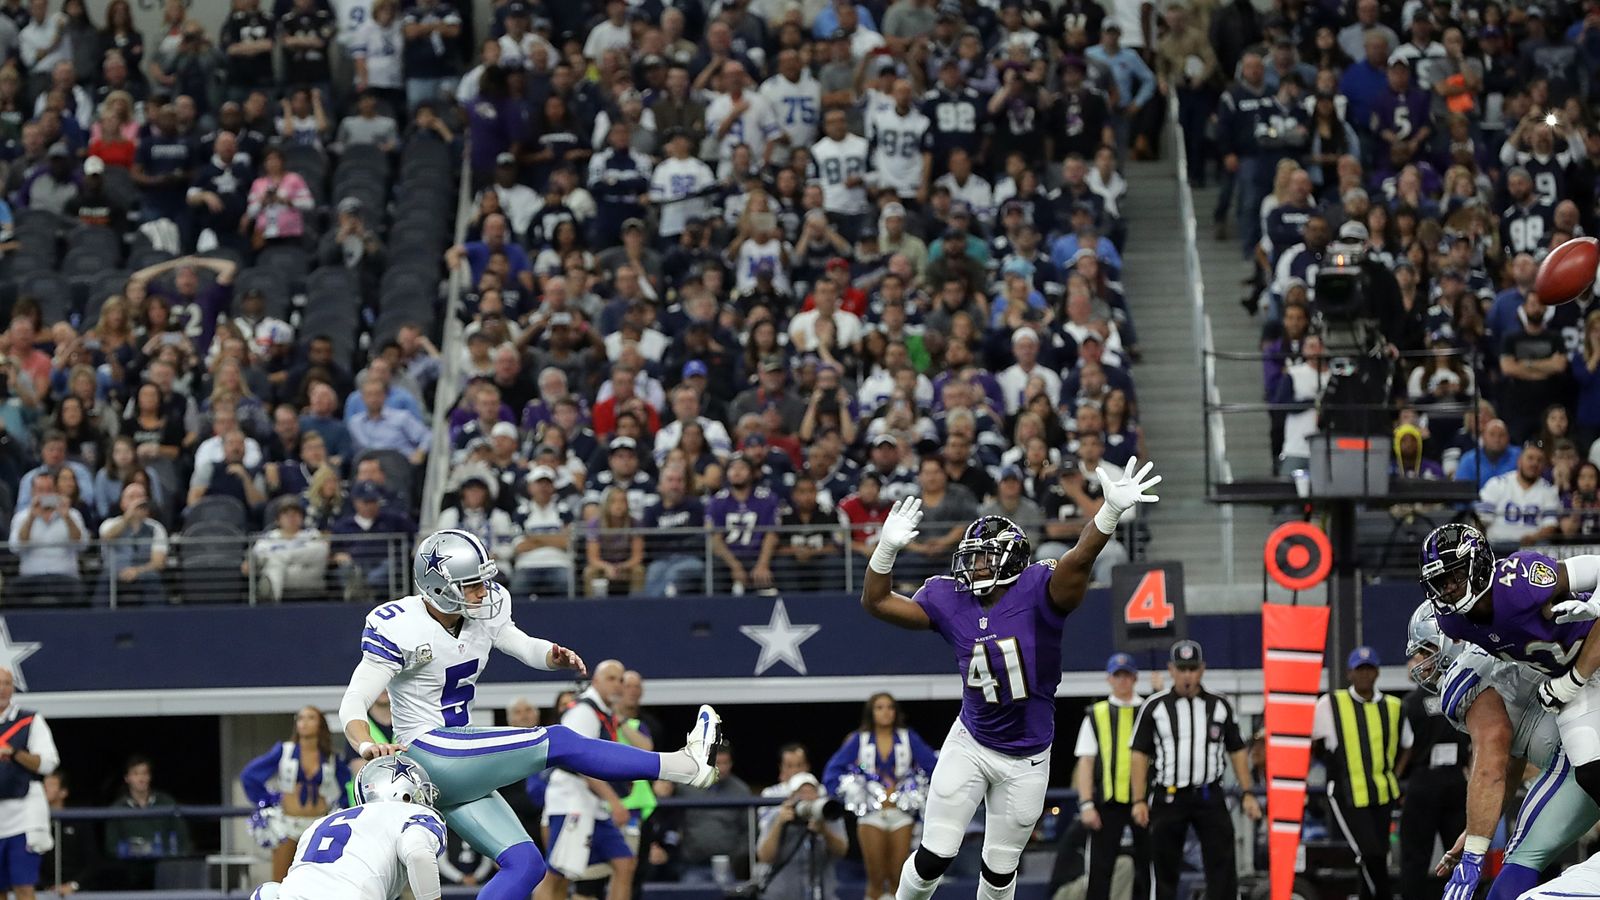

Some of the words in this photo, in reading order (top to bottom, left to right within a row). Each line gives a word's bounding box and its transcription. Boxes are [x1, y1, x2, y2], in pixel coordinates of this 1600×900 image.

[781, 96, 820, 126] 75
[936, 102, 976, 132] 92
[1393, 106, 1411, 141] 5
[1535, 171, 1557, 206] 9
[726, 512, 757, 546] 57
[1498, 557, 1519, 587] 42
[374, 603, 405, 621] 5
[1123, 568, 1175, 629] 4
[966, 636, 1028, 704] 41
[439, 653, 481, 728] 5
[300, 806, 365, 864] 6
